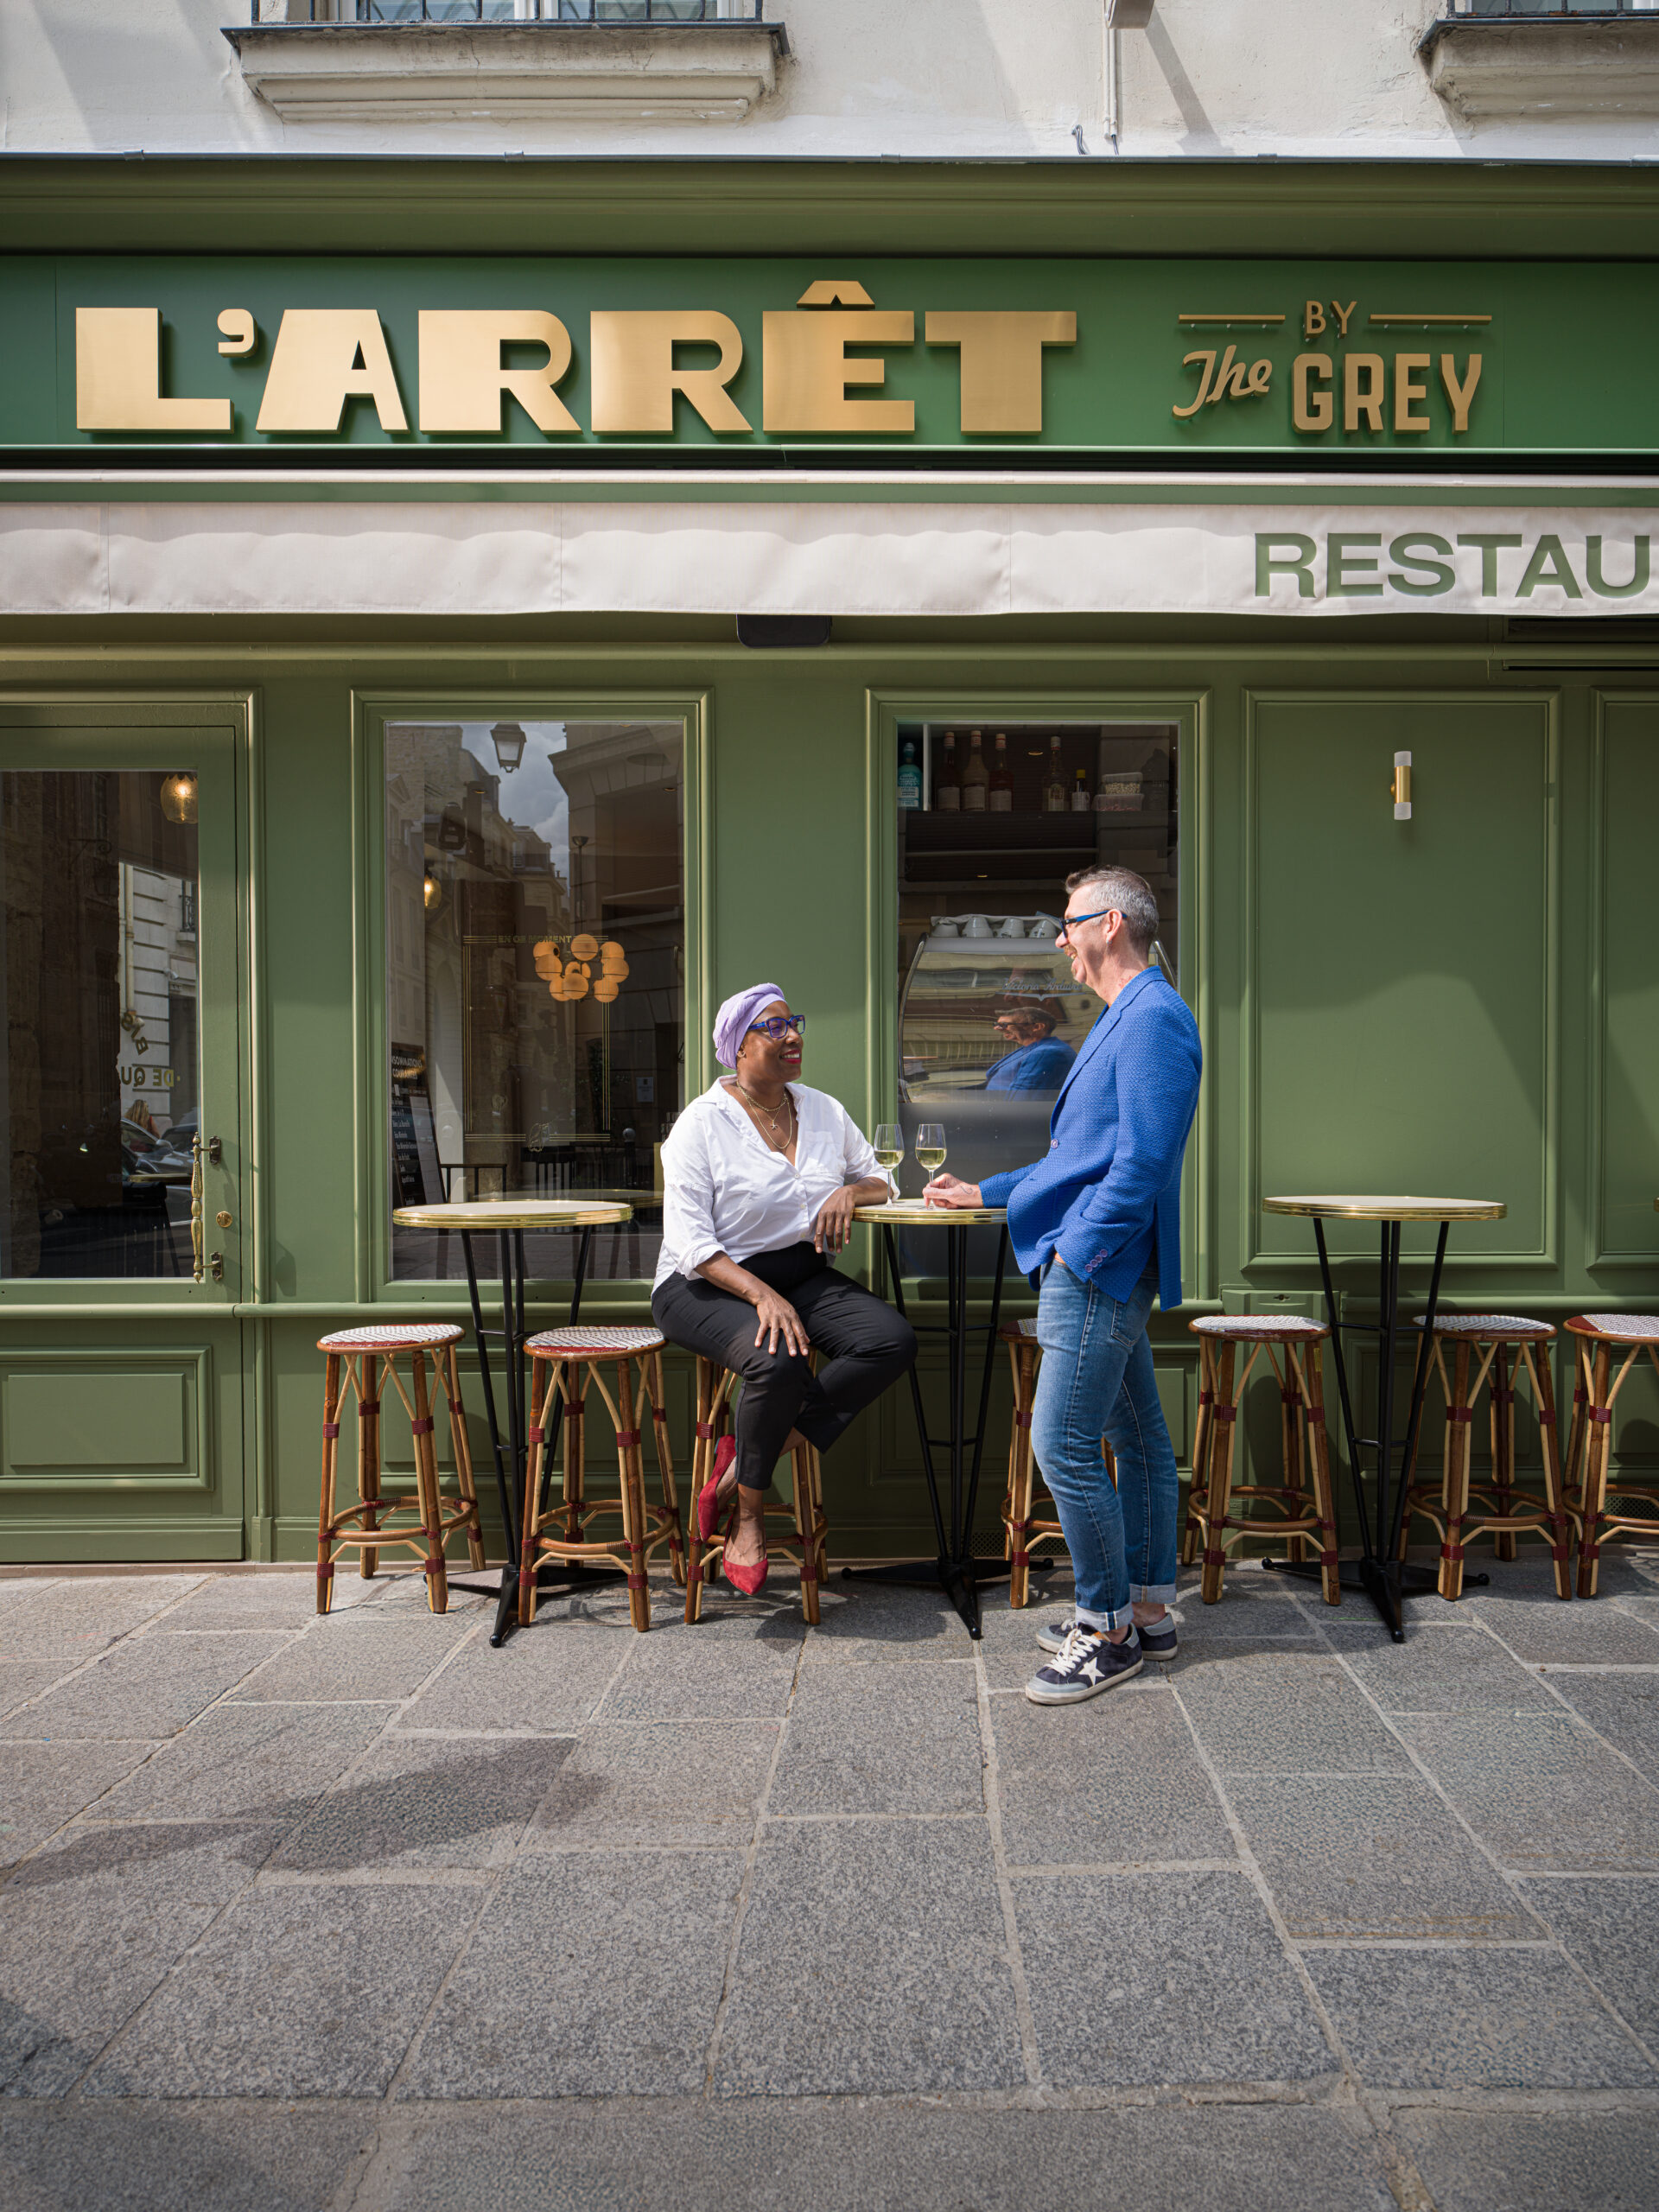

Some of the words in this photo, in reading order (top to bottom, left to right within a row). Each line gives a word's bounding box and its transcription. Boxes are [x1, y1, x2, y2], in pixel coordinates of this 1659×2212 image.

[76, 280, 1077, 435] L'ARRÊT
[1304, 301, 1357, 340] BY
[1172, 345, 1273, 421] The
[1292, 353, 1483, 435] GREY
[1255, 532, 1650, 599] RESTAU
